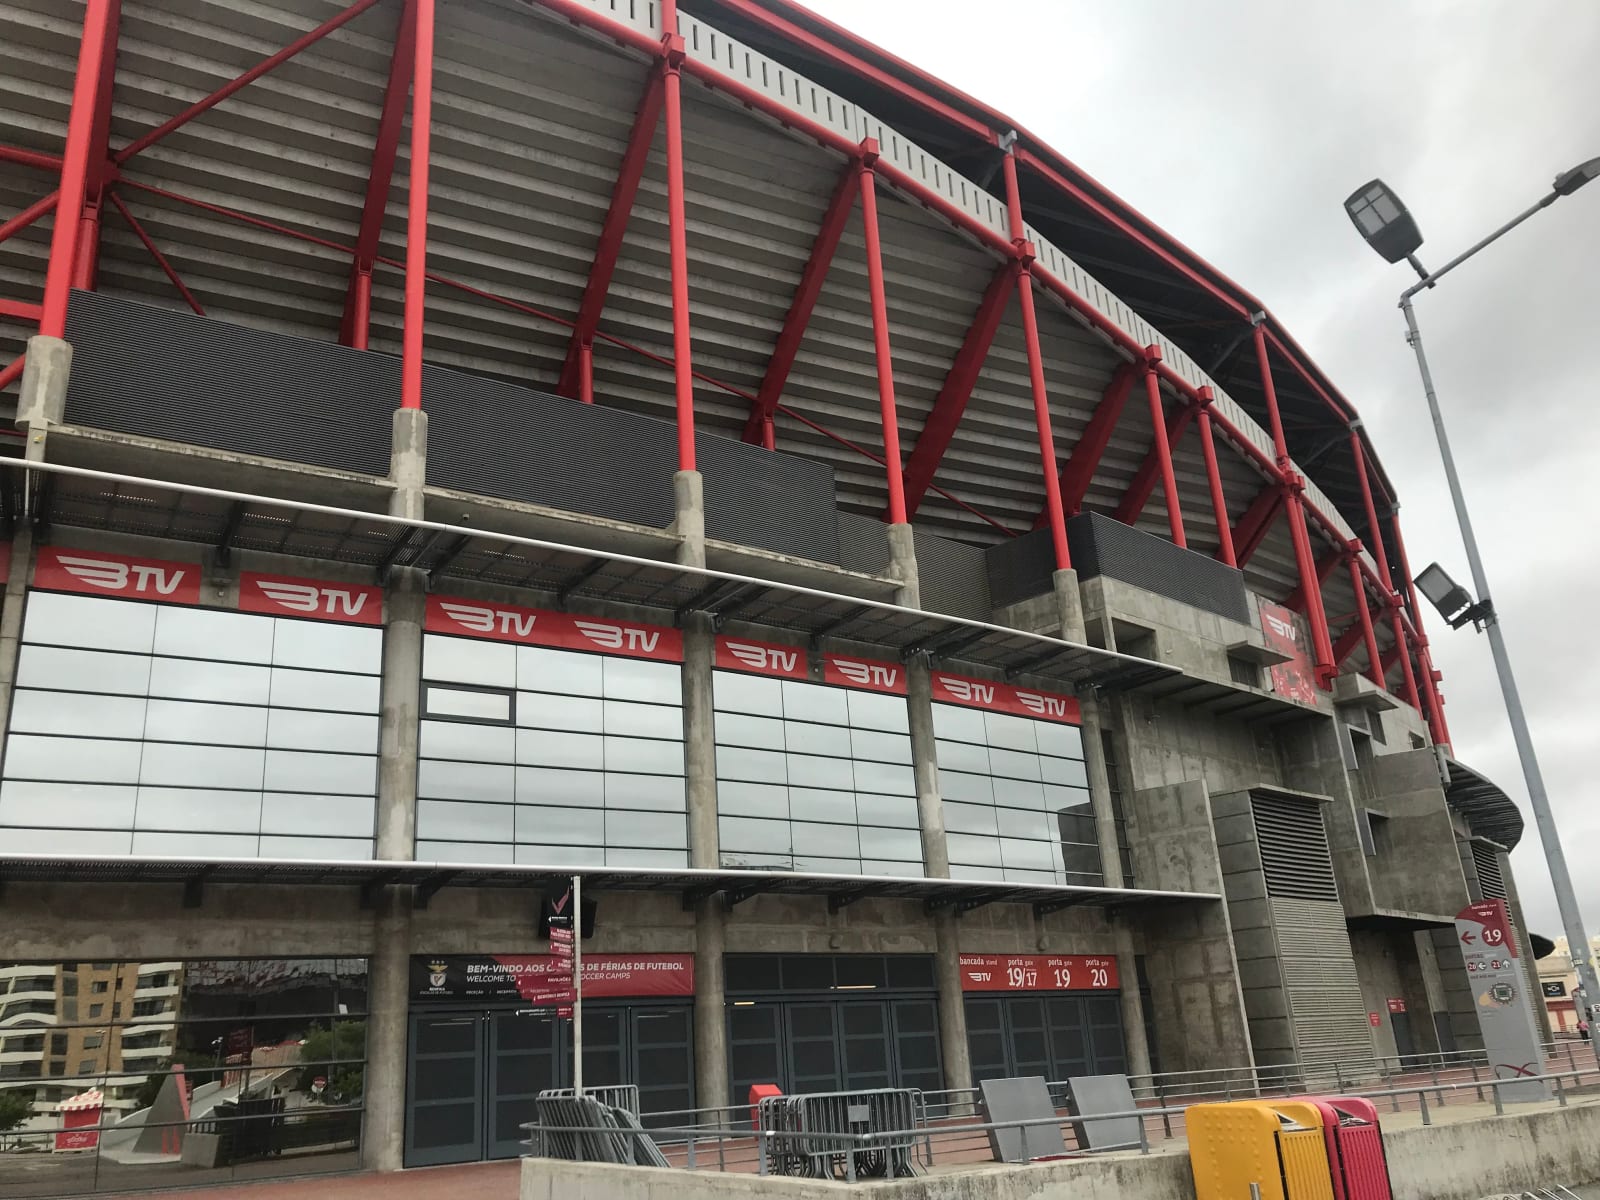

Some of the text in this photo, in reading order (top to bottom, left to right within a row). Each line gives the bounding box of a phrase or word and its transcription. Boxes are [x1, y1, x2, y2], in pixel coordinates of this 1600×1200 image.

[1484, 929, 1502, 943] 19
[959, 956, 985, 966] bancada
[1007, 958, 1024, 967] porta
[1048, 958, 1063, 967] porta
[1085, 958, 1100, 967] porta
[467, 964, 523, 973] BEM-VINDO
[525, 964, 545, 973] AOS
[587, 963, 599, 971] DE
[601, 961, 633, 971] FÉRIAS
[633, 962, 646, 970] DE
[646, 962, 685, 970] FUTEBOL
[466, 974, 505, 983] WELCOME
[580, 972, 605, 981] OCCER
[605, 972, 631, 980] CAMPS
[1054, 968, 1071, 988] 19
[1090, 968, 1108, 987] 20
